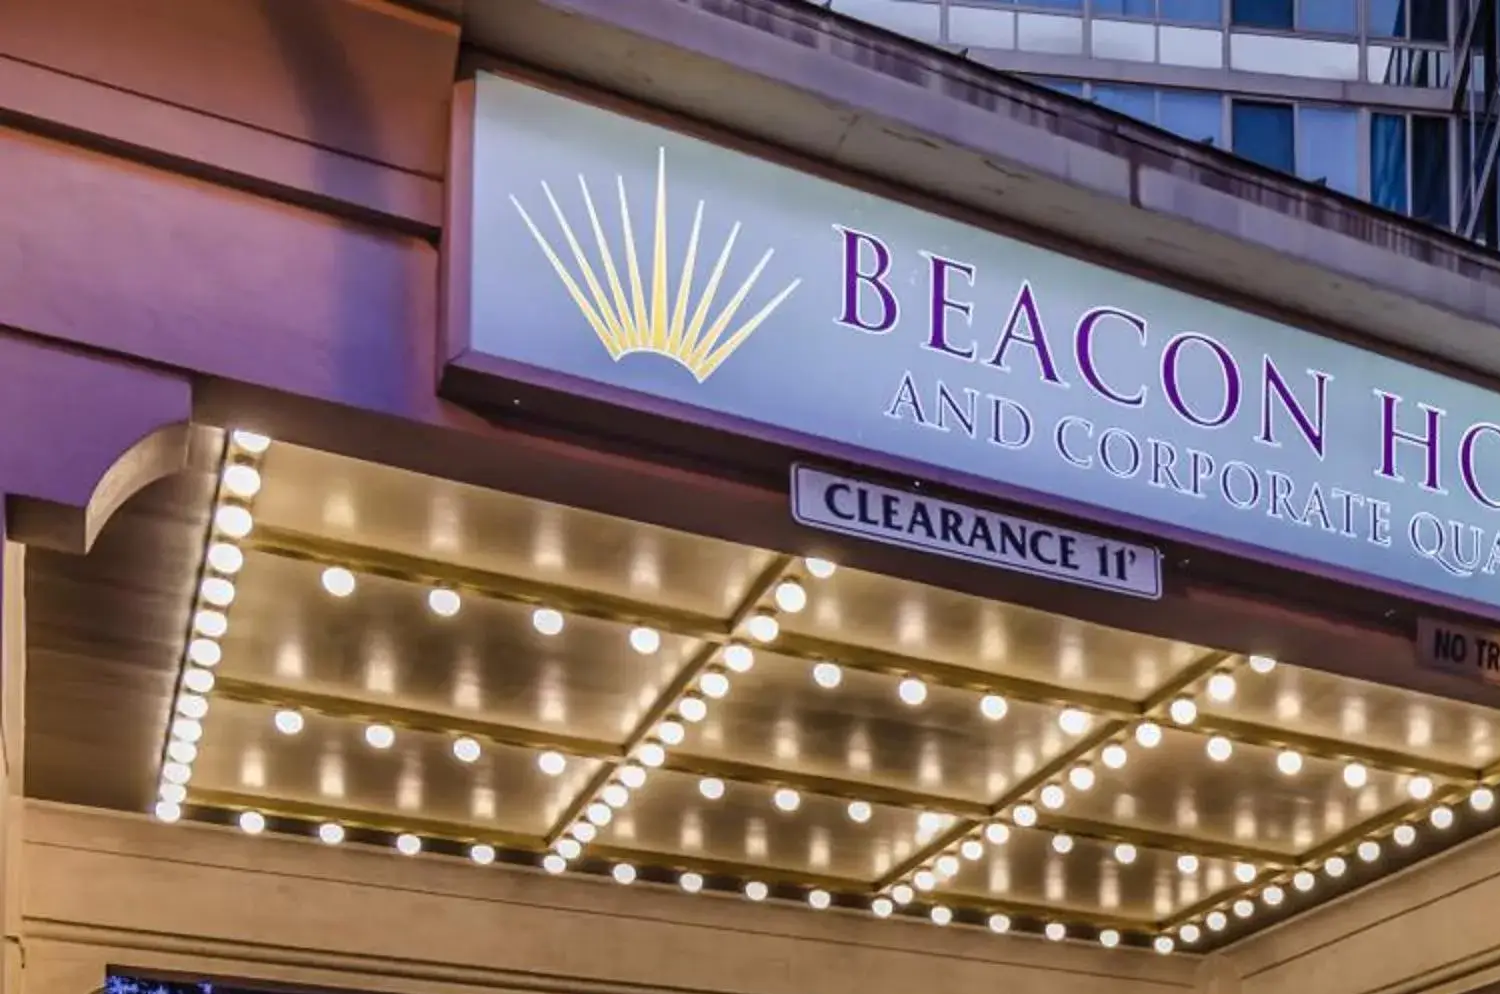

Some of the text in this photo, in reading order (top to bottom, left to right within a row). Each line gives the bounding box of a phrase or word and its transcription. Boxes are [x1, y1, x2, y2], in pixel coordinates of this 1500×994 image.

[832, 223, 1334, 461] BEACON
[885, 370, 1034, 449] AND
[1053, 415, 1392, 547] CORPORATE
[824, 483, 1079, 570] CLEARANCE
[1434, 628, 1467, 662] NO
